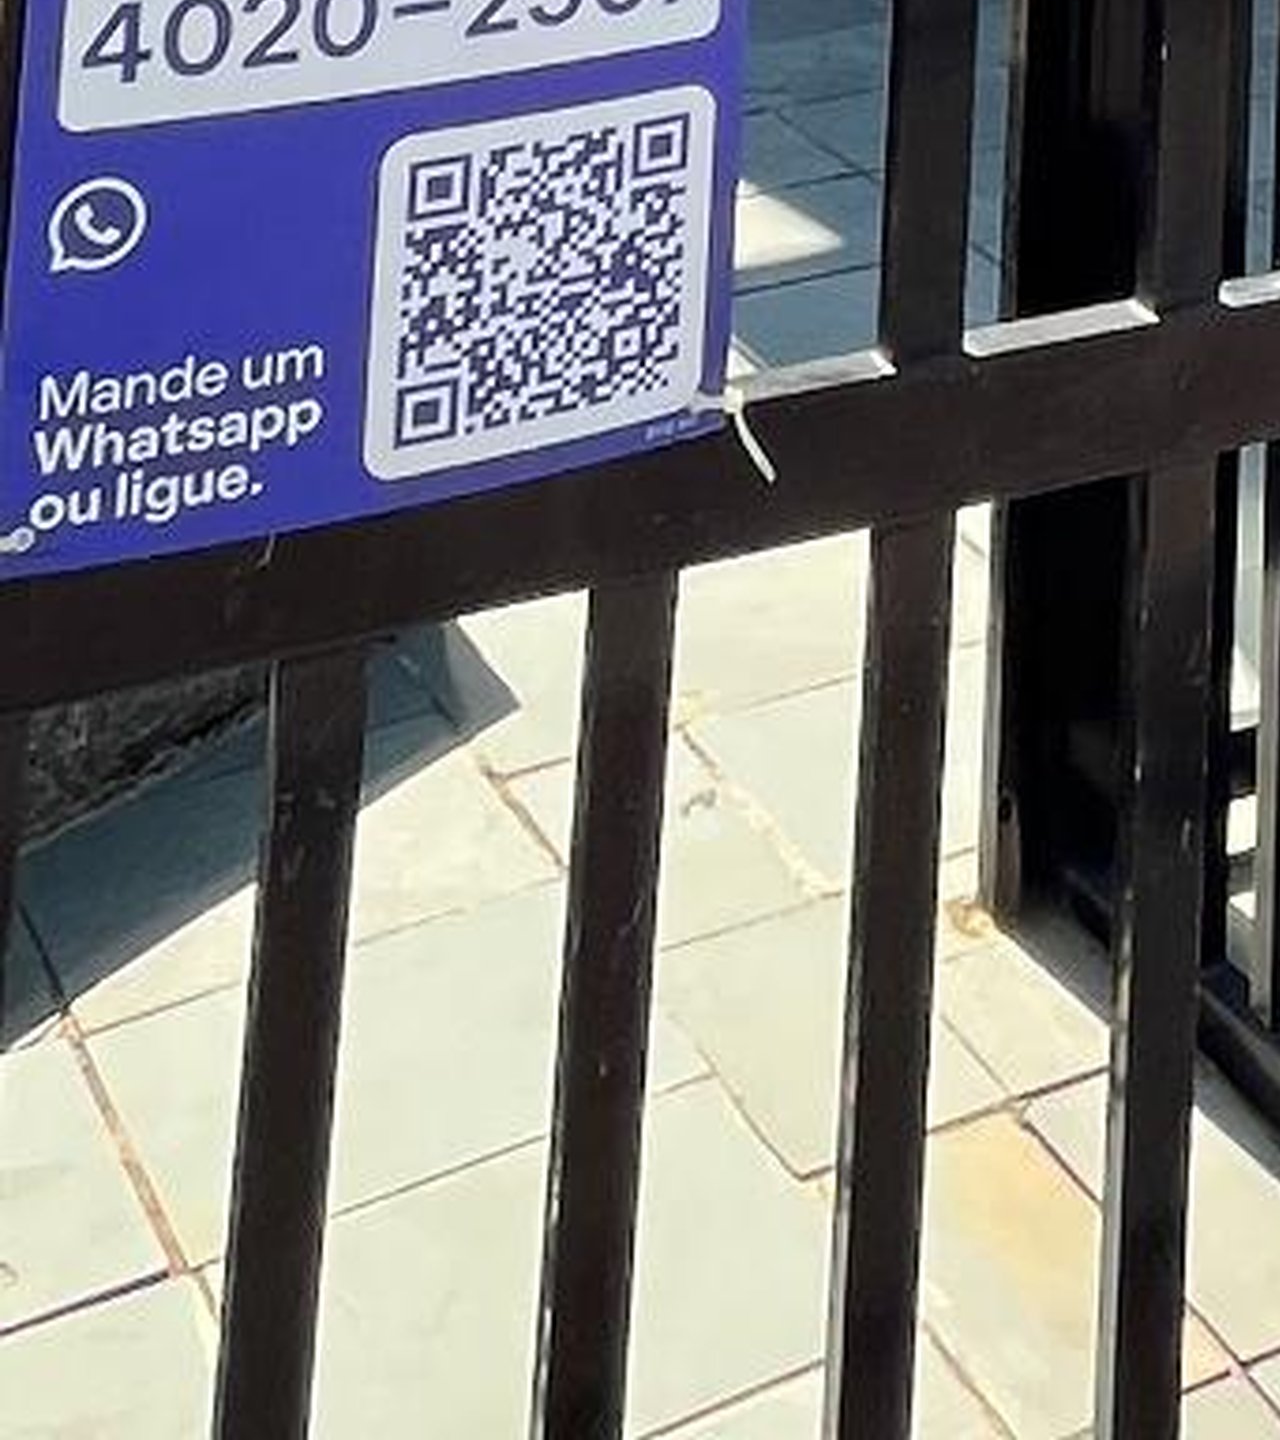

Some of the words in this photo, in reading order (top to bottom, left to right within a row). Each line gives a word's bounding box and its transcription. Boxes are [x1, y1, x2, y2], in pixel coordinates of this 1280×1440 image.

[39, 355, 229, 421] Mande
[242, 344, 324, 389] um
[34, 399, 322, 475] Whatsapp
[29, 487, 101, 530] ou
[115, 465, 263, 523] ligue.
